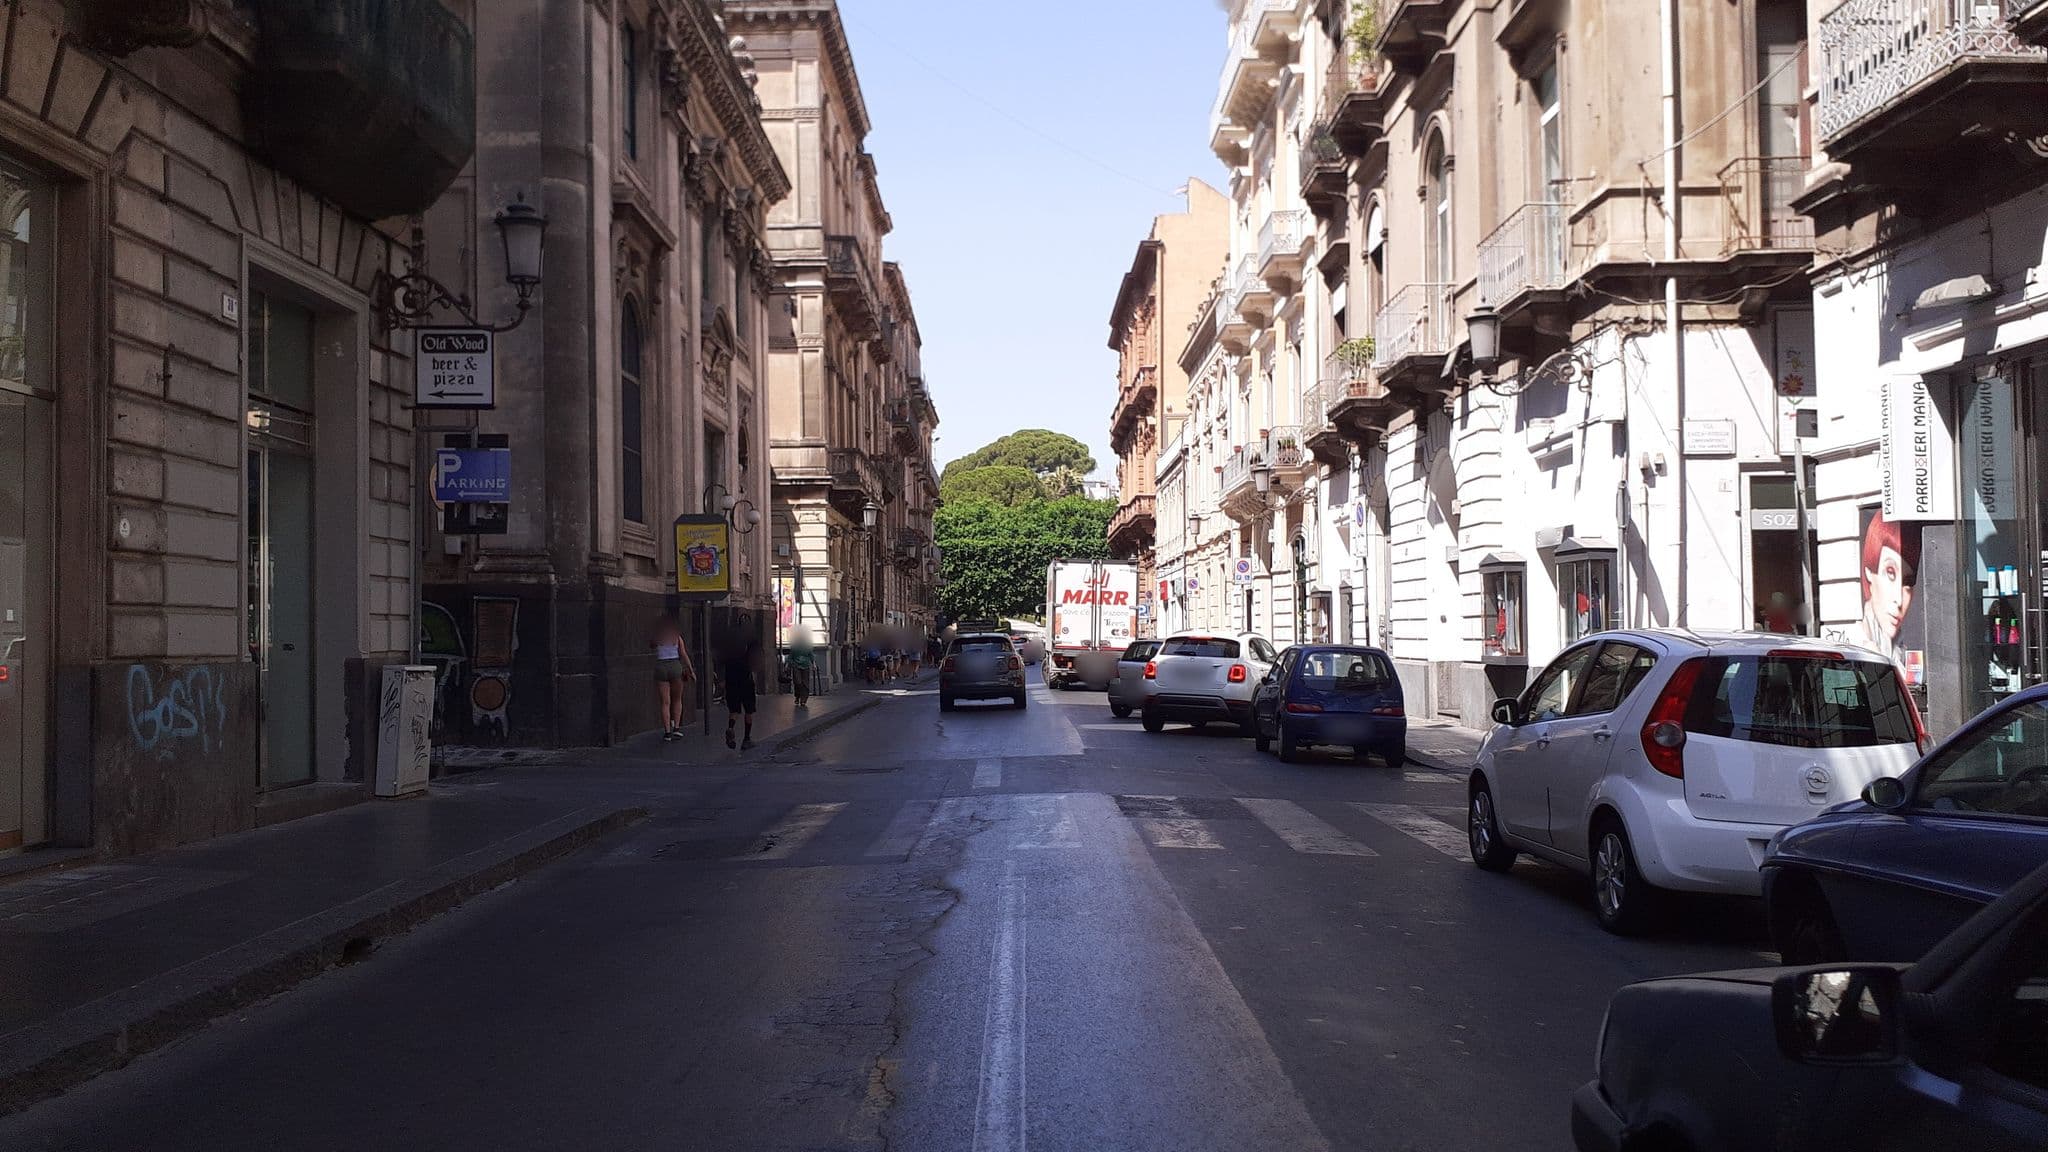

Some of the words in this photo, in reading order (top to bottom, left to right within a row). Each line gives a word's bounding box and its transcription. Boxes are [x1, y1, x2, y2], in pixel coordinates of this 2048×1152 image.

[424, 336, 446, 350] Old
[447, 336, 484, 350] Wood
[432, 356, 460, 370] beer
[464, 356, 478, 370] &
[434, 371, 474, 387] pizza
[1880, 383, 1889, 429] MANIA
[1913, 381, 1926, 427] MANIA
[438, 453, 507, 488] PARKING
[1062, 589, 1129, 606] MARR
